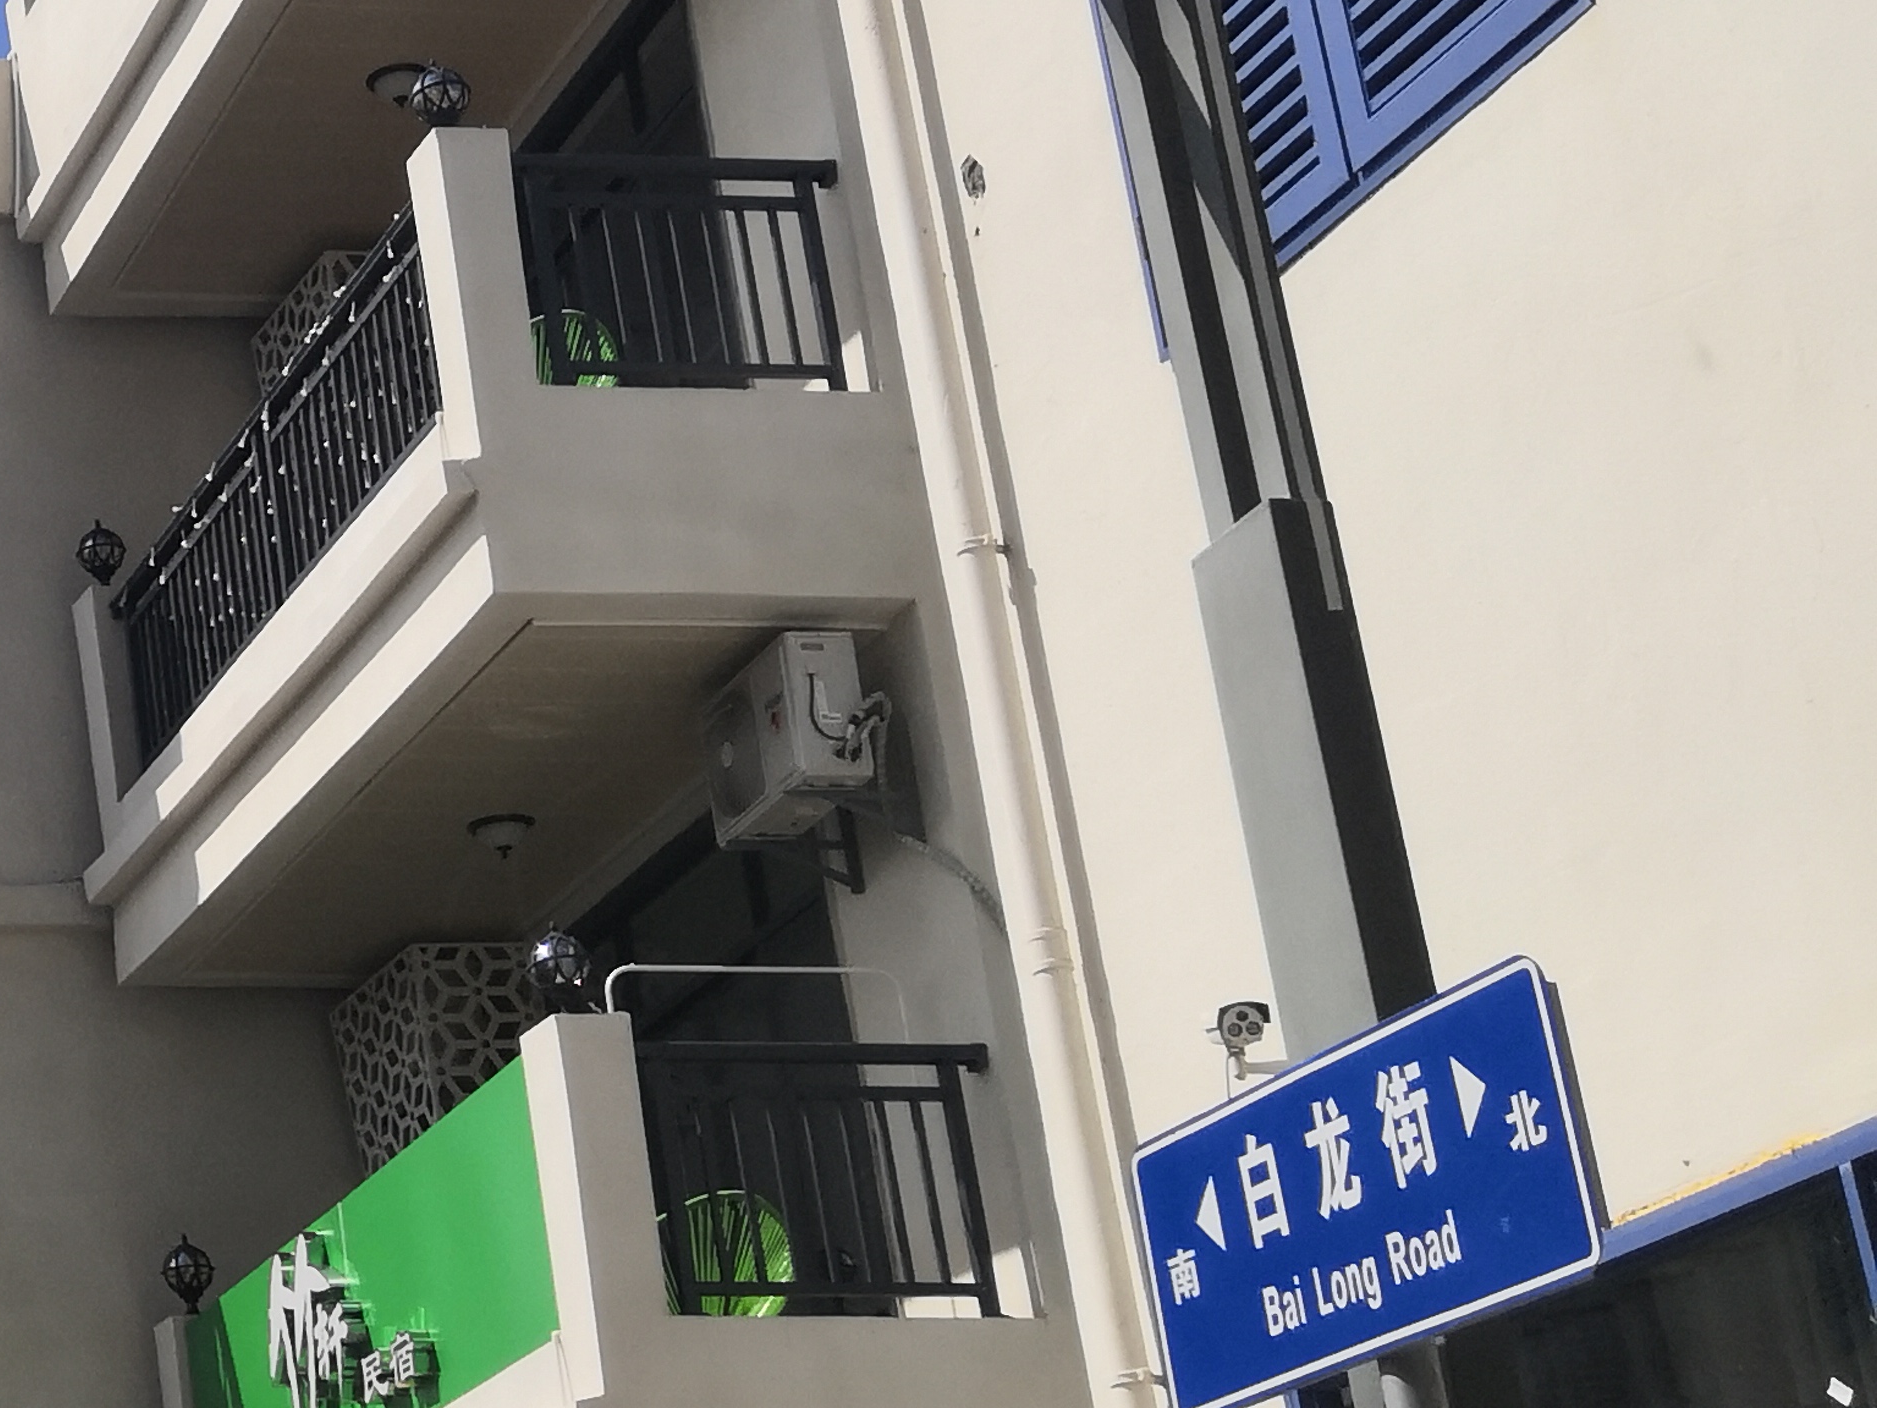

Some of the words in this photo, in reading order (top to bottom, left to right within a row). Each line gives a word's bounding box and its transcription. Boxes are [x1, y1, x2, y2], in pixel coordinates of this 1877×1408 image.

[1166, 1247, 1201, 1305] 南
[1237, 1060, 1439, 1251] 白龙街
[1504, 1088, 1548, 1153] 北
[1261, 1283, 1307, 1338] Bai
[1312, 1256, 1383, 1319] Long
[1385, 1208, 1462, 1285] Road
